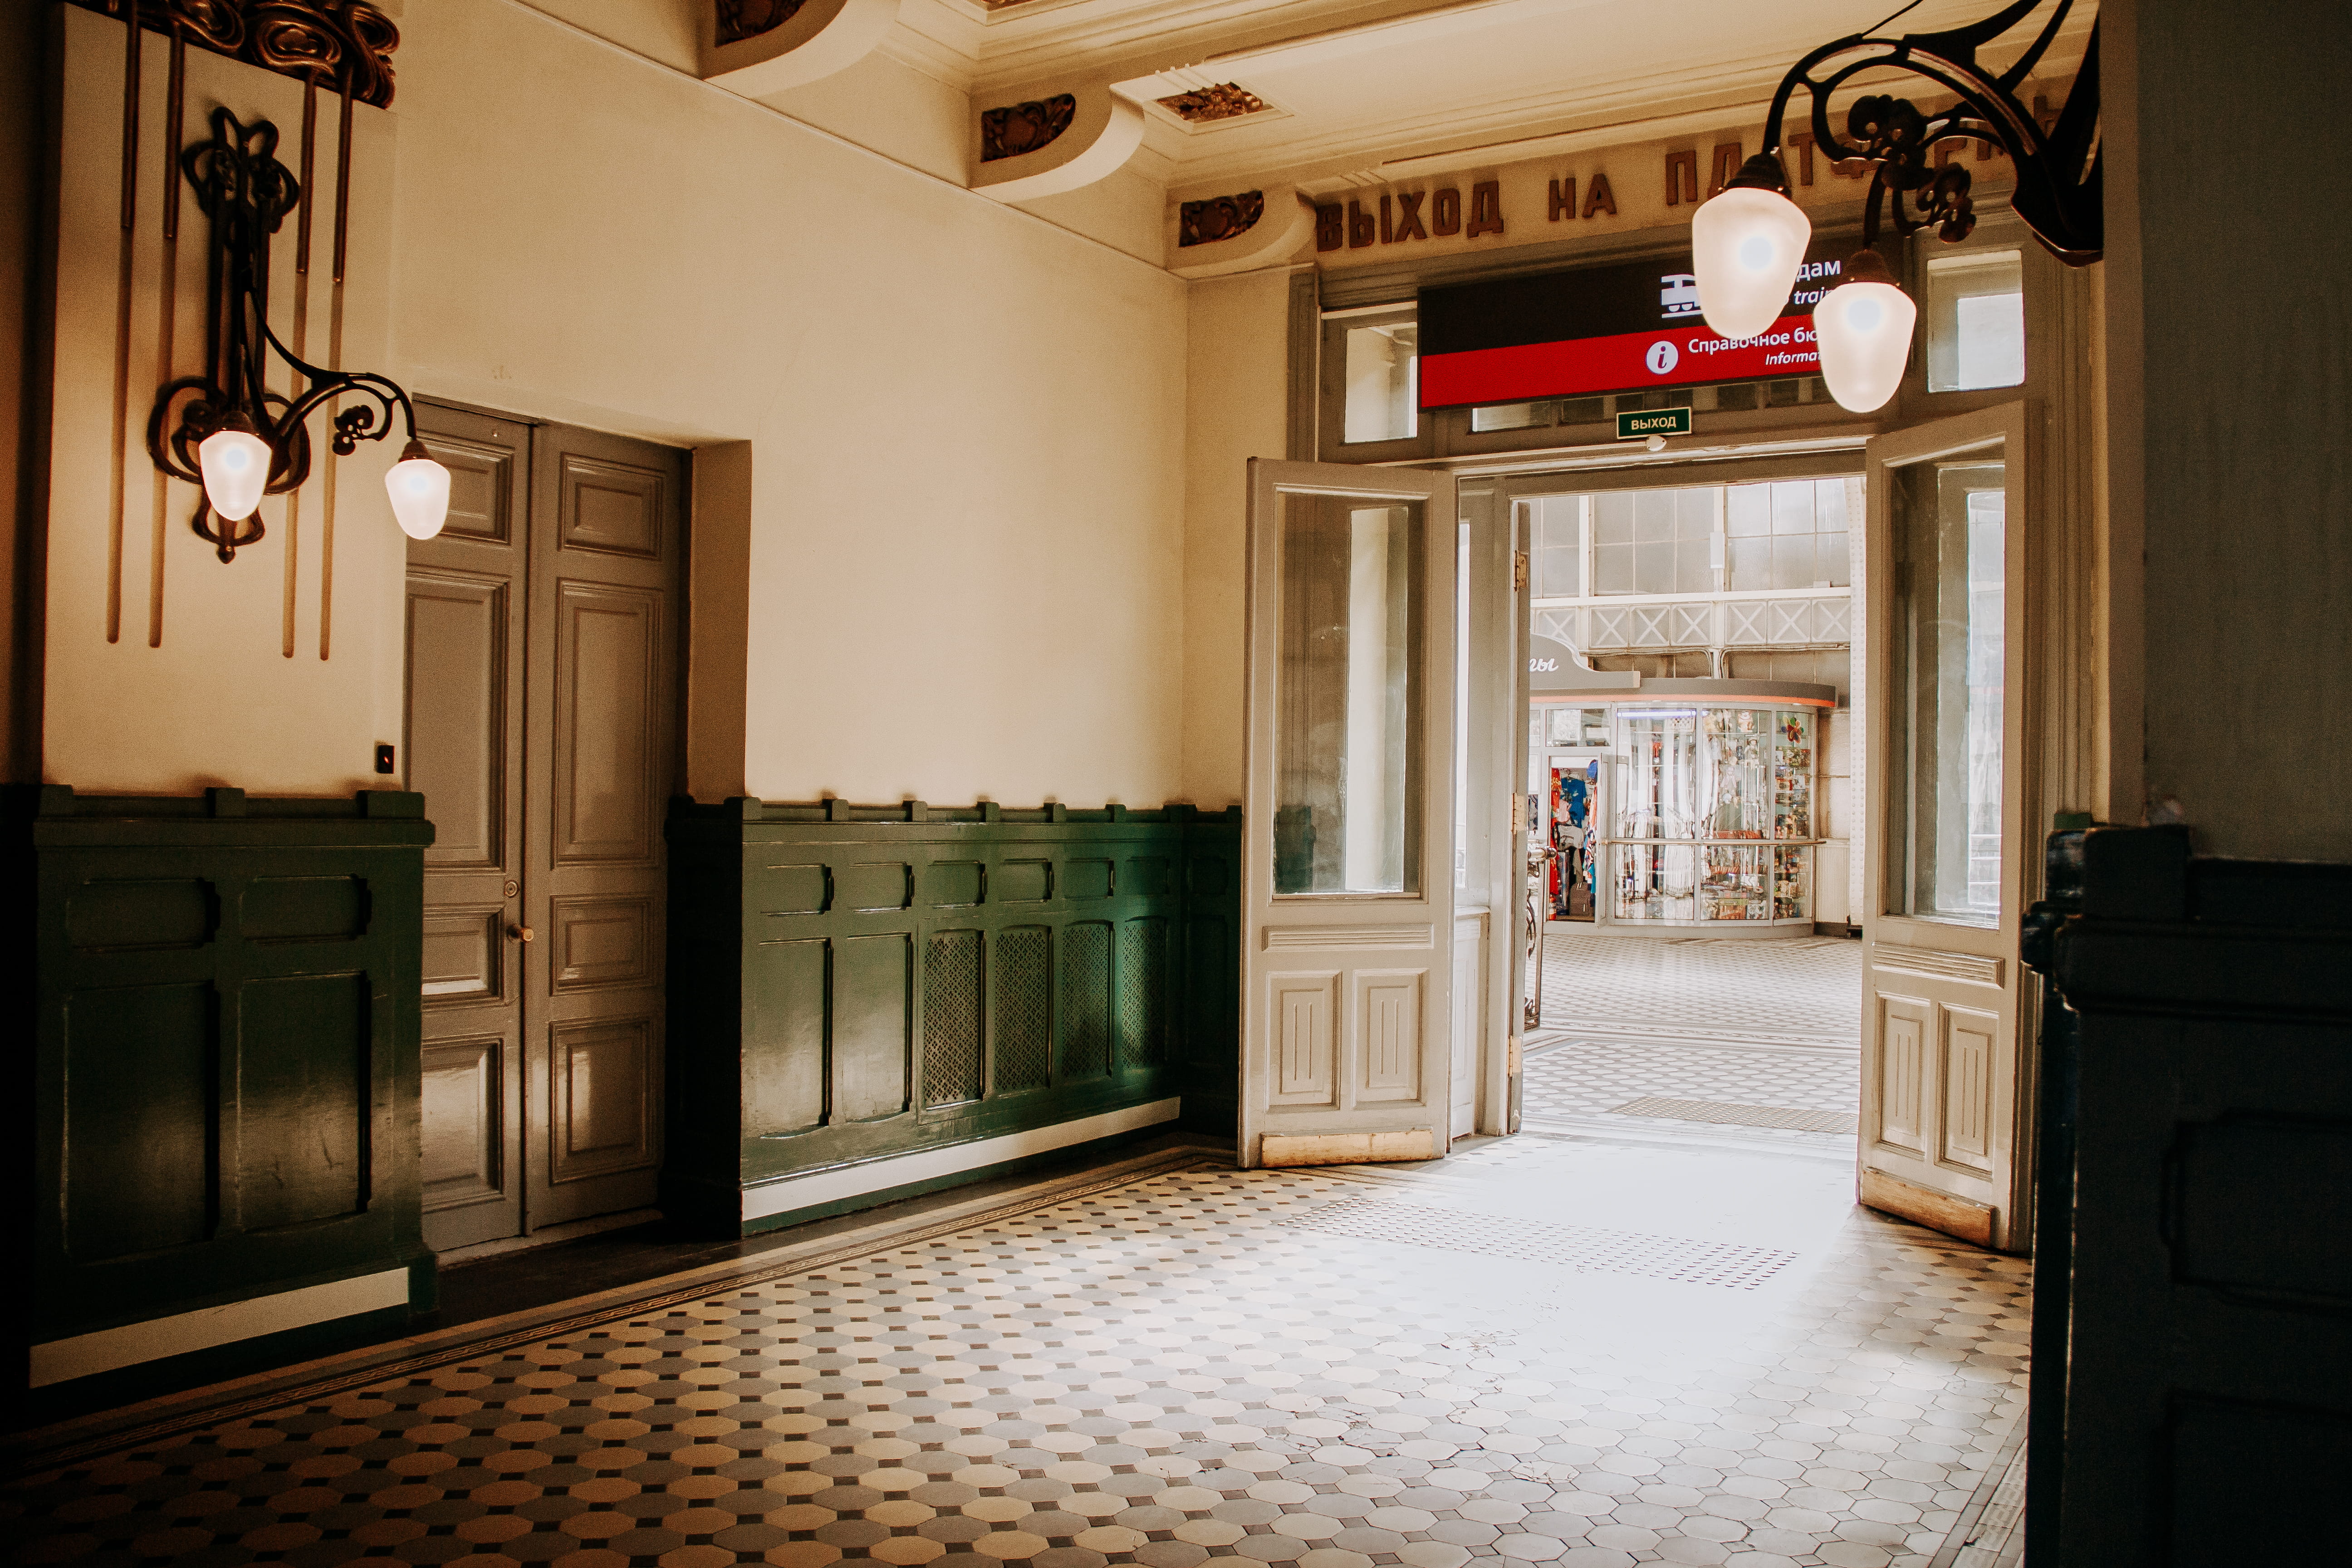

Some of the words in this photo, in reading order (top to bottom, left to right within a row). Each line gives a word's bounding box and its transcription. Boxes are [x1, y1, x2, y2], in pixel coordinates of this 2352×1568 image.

[1316, 181, 1504, 252] ВЫХОД
[1548, 173, 1617, 221] НА
[1688, 333, 1790, 355] Справочное
[1631, 416, 1677, 431] ВЫХОД
